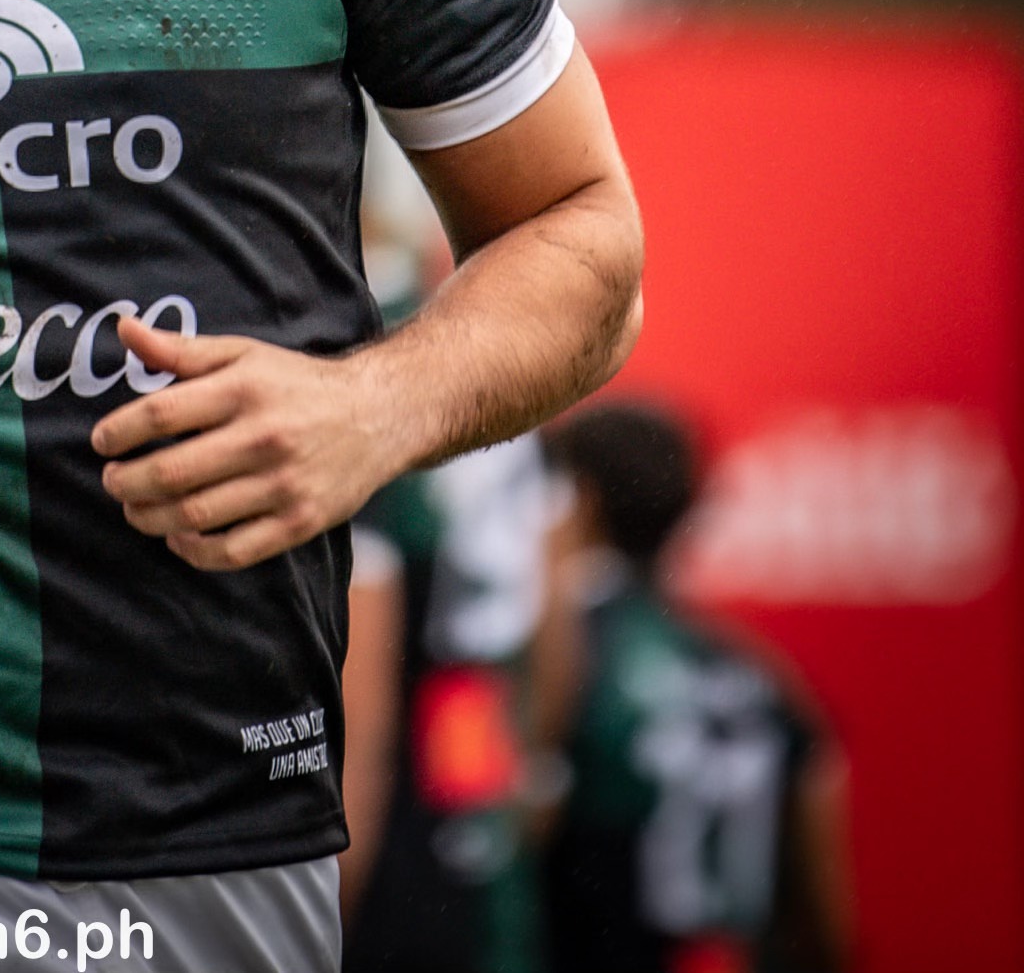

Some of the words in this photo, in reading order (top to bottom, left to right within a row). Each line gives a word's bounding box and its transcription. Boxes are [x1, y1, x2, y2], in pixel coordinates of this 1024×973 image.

[240, 724, 271, 753] MAS
[266, 718, 296, 747] QUE
[291, 713, 311, 741] UN
[269, 752, 296, 781] UNA
